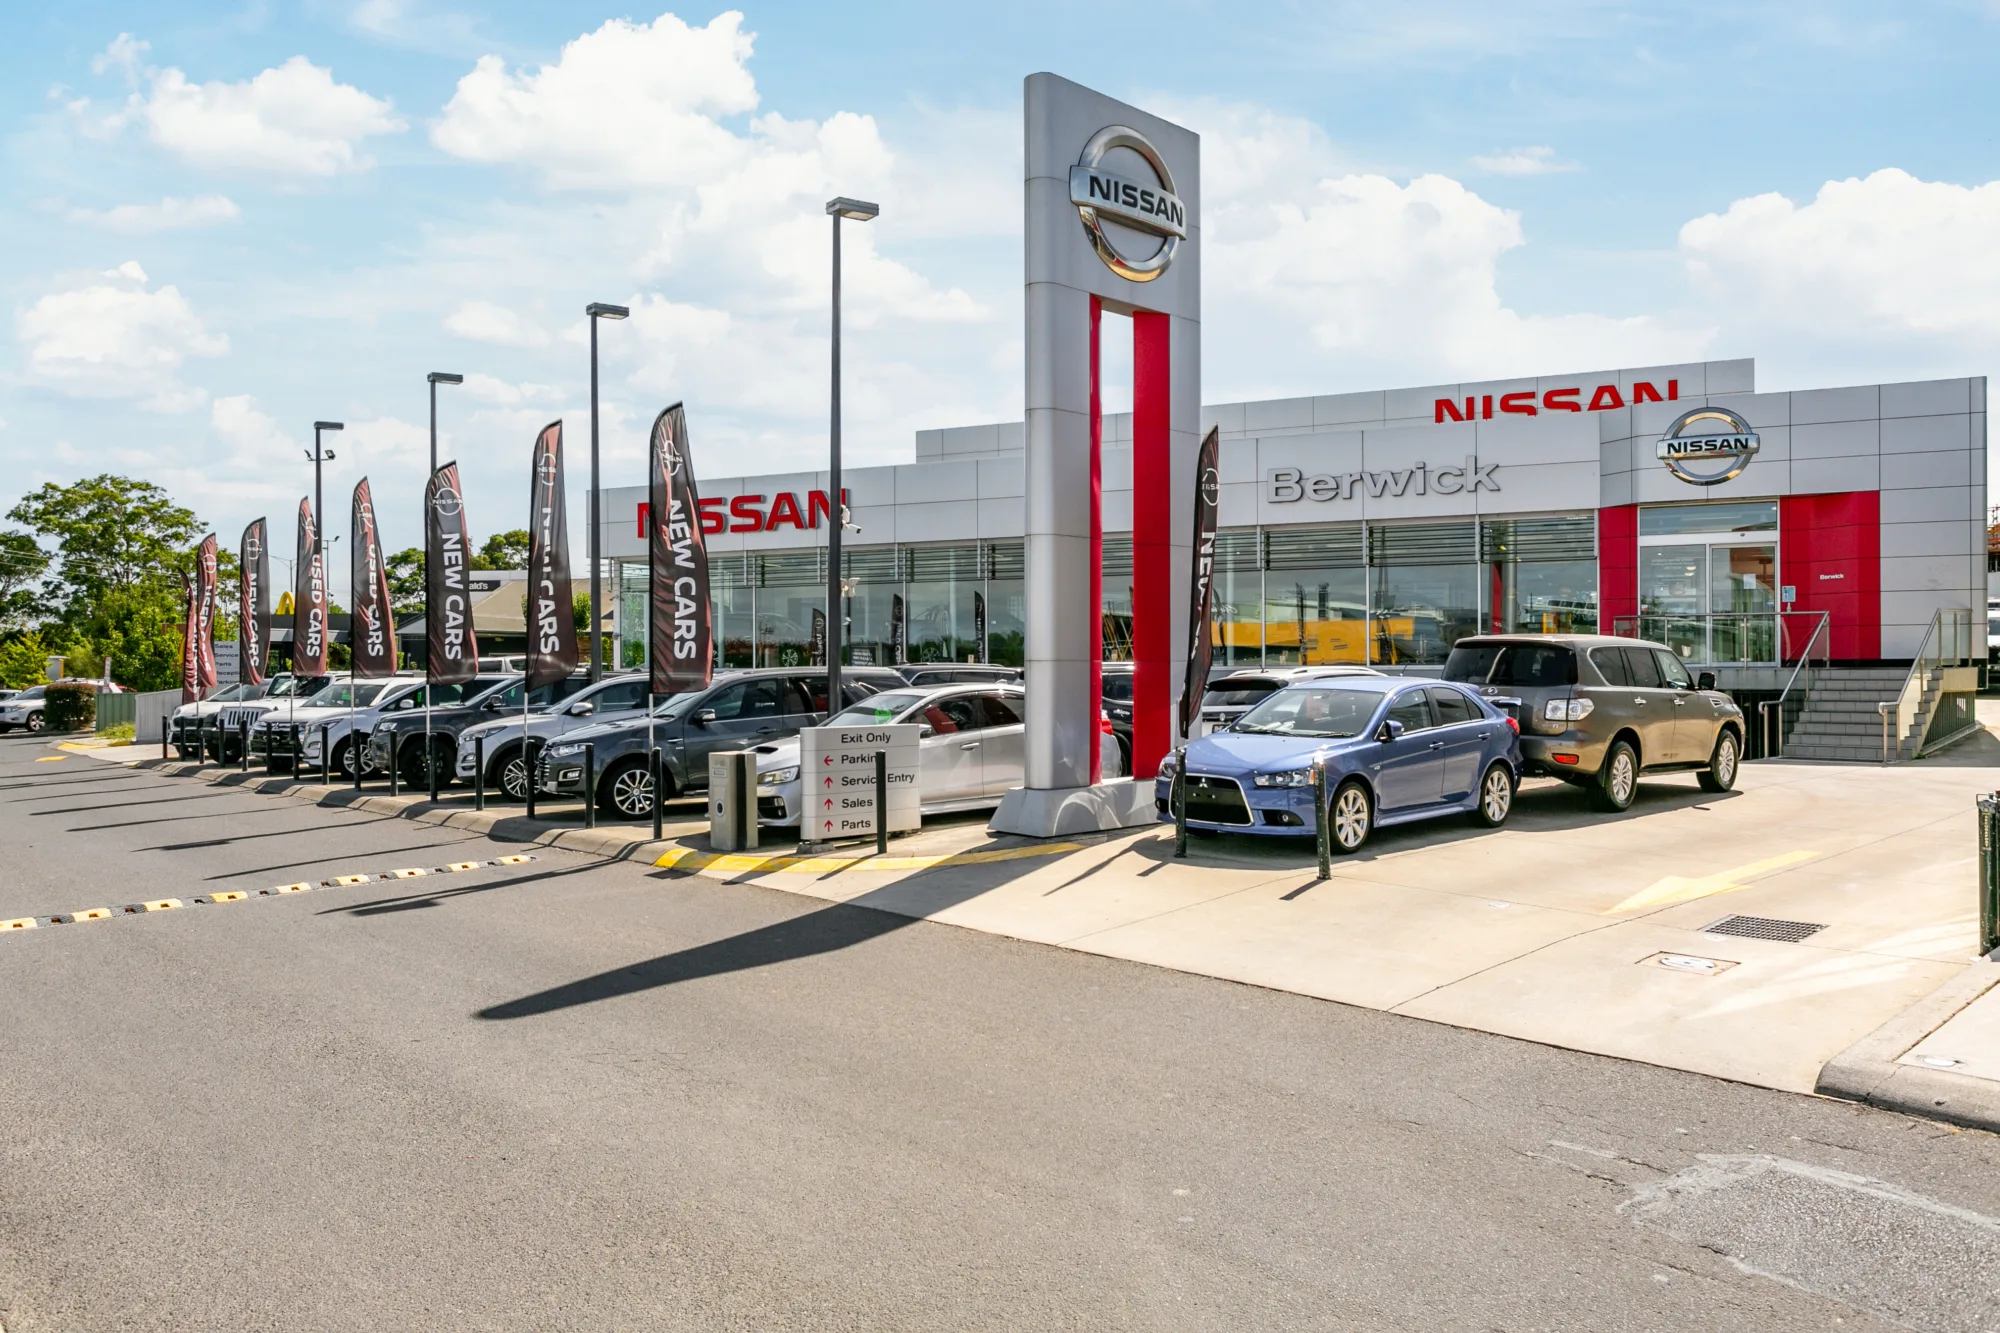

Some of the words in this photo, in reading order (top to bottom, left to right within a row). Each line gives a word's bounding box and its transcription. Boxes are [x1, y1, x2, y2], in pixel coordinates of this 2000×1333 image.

[1089, 174, 1183, 228] NISSAN
[1435, 379, 1678, 424] NISSAN
[1667, 437, 1749, 455] NISSAN
[1267, 455, 1501, 503] Berwick
[637, 488, 847, 539] SSAN
[669, 499, 696, 569] NEW
[311, 554, 323, 604] USED
[368, 543, 378, 599] USED
[442, 533, 464, 590] NEW
[249, 573, 258, 616] NEW
[469, 582, 488, 590] ald's
[306, 608, 322, 657] CARS
[367, 604, 384, 657] CARS
[445, 595, 464, 660] CARS
[538, 579, 560, 654] CARS
[673, 577, 697, 660] CARS
[249, 619, 260, 667] CARS
[841, 733, 863, 744] Exit
[866, 732, 891, 744] Only
[841, 753, 877, 764] Parkin
[841, 775, 877, 786] Servic
[887, 773, 915, 784] Entry
[841, 798, 873, 809] Sales
[841, 819, 871, 830] Parts
